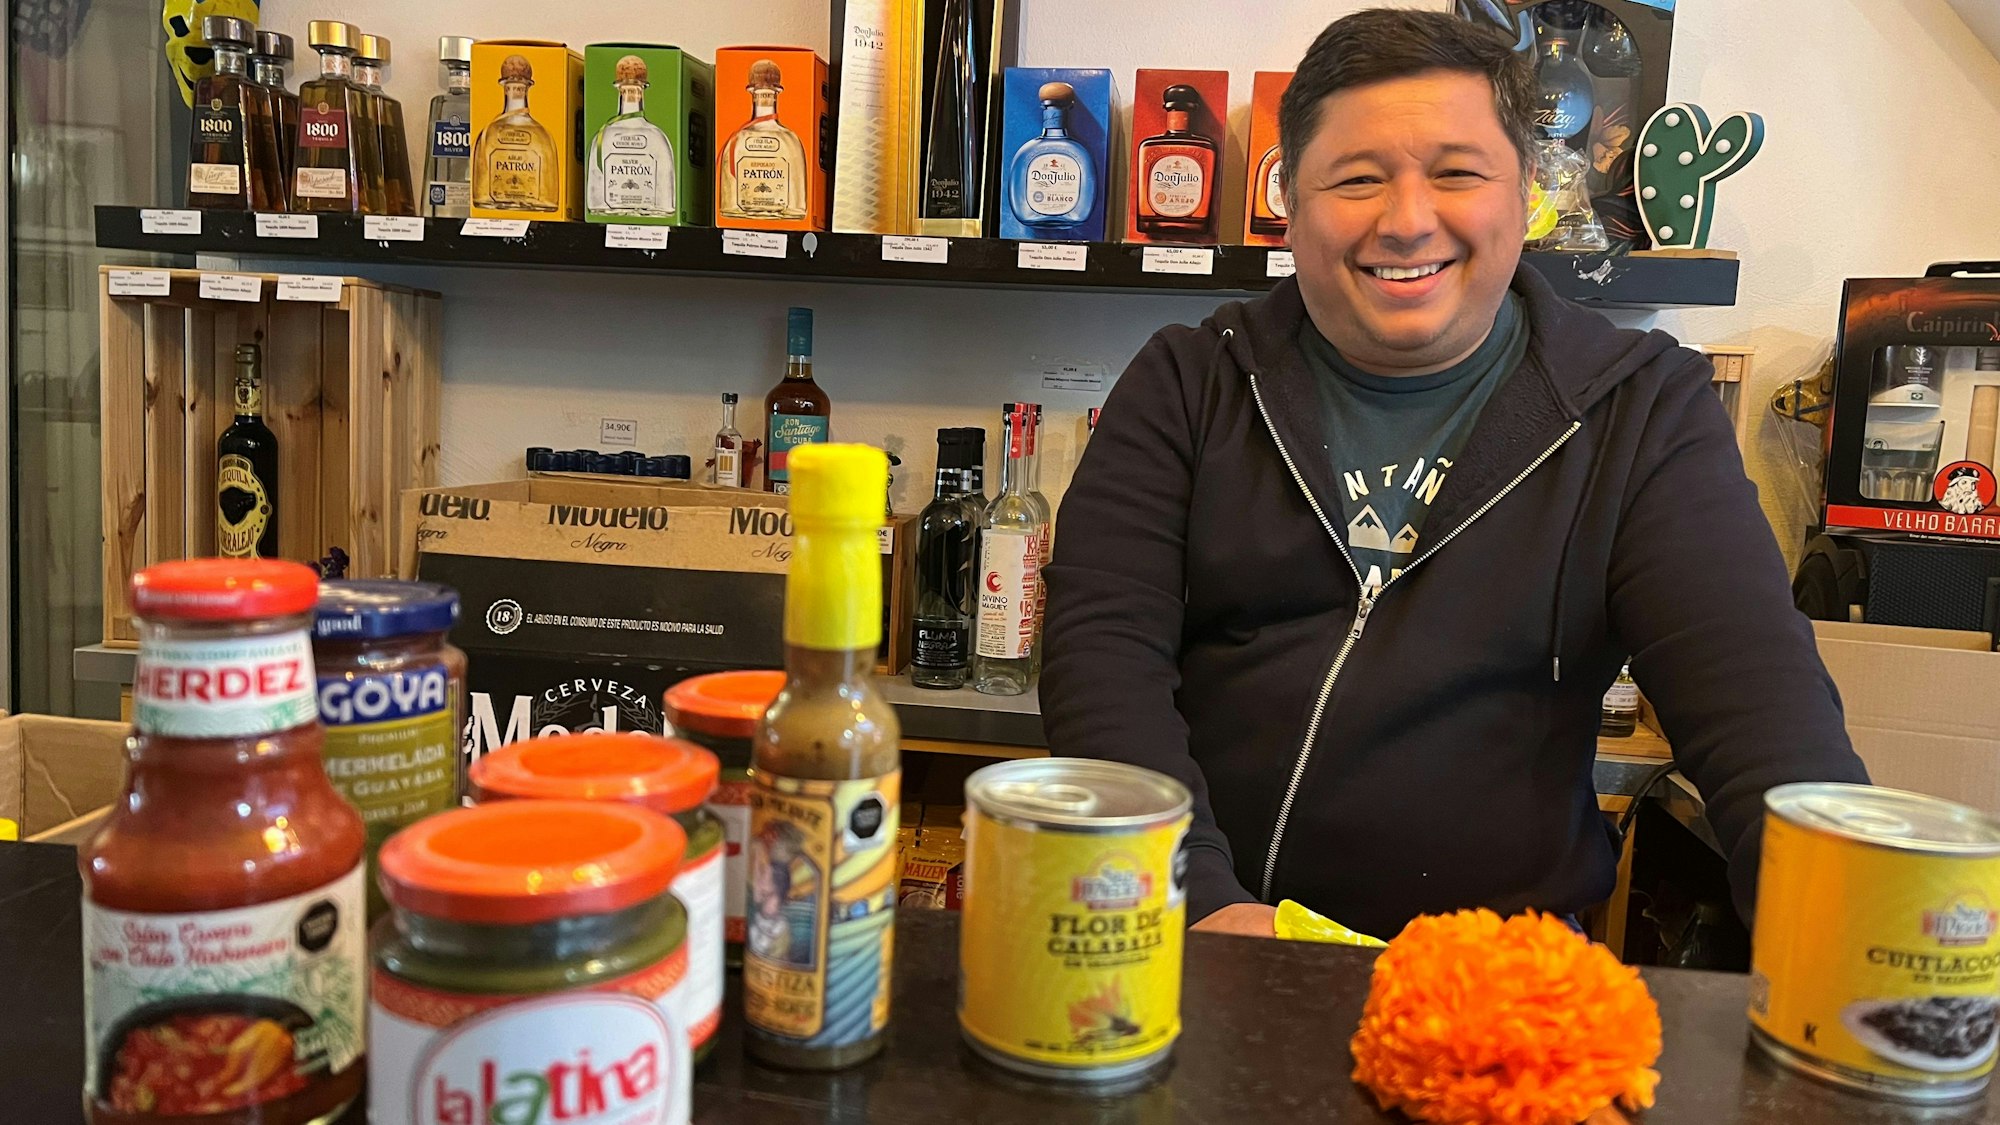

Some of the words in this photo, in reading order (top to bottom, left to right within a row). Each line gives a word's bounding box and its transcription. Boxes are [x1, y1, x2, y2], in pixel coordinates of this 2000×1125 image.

[854, 38, 884, 50] 1942
[200, 119, 232, 133] 1800
[306, 122, 339, 137] 1800
[436, 131, 471, 147] 1800
[931, 190, 960, 198] 1942
[604, 422, 631, 431] 34,90€
[784, 418, 800, 426] RON
[774, 423, 822, 439] Santiago
[1883, 511, 1939, 531] VELHO
[1944, 515, 2000, 536] BARR
[571, 532, 627, 552] Negra
[982, 594, 1008, 604] DIVINO
[526, 613, 533, 624] EL
[534, 613, 553, 625] ABUSO
[553, 614, 562, 625] EN
[562, 615, 569, 626] EL
[569, 616, 598, 628] CONSUMO
[598, 617, 607, 628] DE
[606, 618, 621, 629] ESTE
[621, 619, 651, 631] PRODUCTO
[651, 621, 660, 631] ES
[660, 621, 681, 632] NOCIVO
[681, 622, 696, 633] PARA
[696, 623, 704, 634] LA
[704, 624, 725, 635] SALUD
[919, 629, 957, 641] PLUMA
[319, 671, 446, 723] GOYA
[544, 678, 648, 710] CERVEZA
[904, 862, 948, 880] MAIZEN
[1050, 913, 1126, 935] FLOR
[1137, 907, 1162, 930] DE
[1803, 1022, 1819, 1047] K
